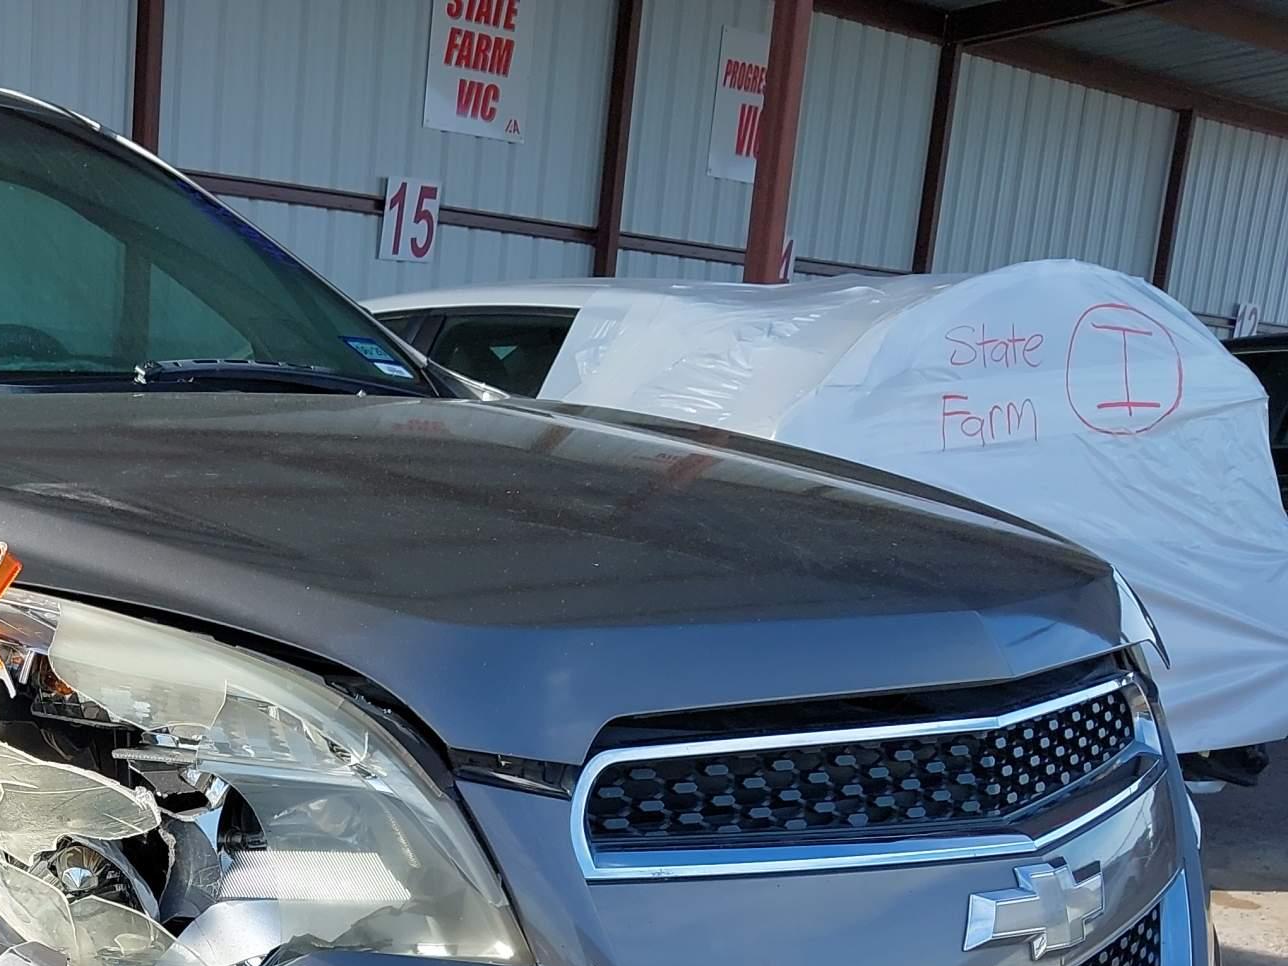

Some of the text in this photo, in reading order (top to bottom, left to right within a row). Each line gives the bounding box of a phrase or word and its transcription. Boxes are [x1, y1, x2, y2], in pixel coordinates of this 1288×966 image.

[446, 0, 521, 32] STATE
[443, 26, 516, 78] FARM
[723, 59, 767, 95] PROGRE
[455, 79, 500, 122] VIC
[389, 181, 438, 258] 15
[945, 323, 1044, 368] State
[941, 393, 1038, 451] Farm
